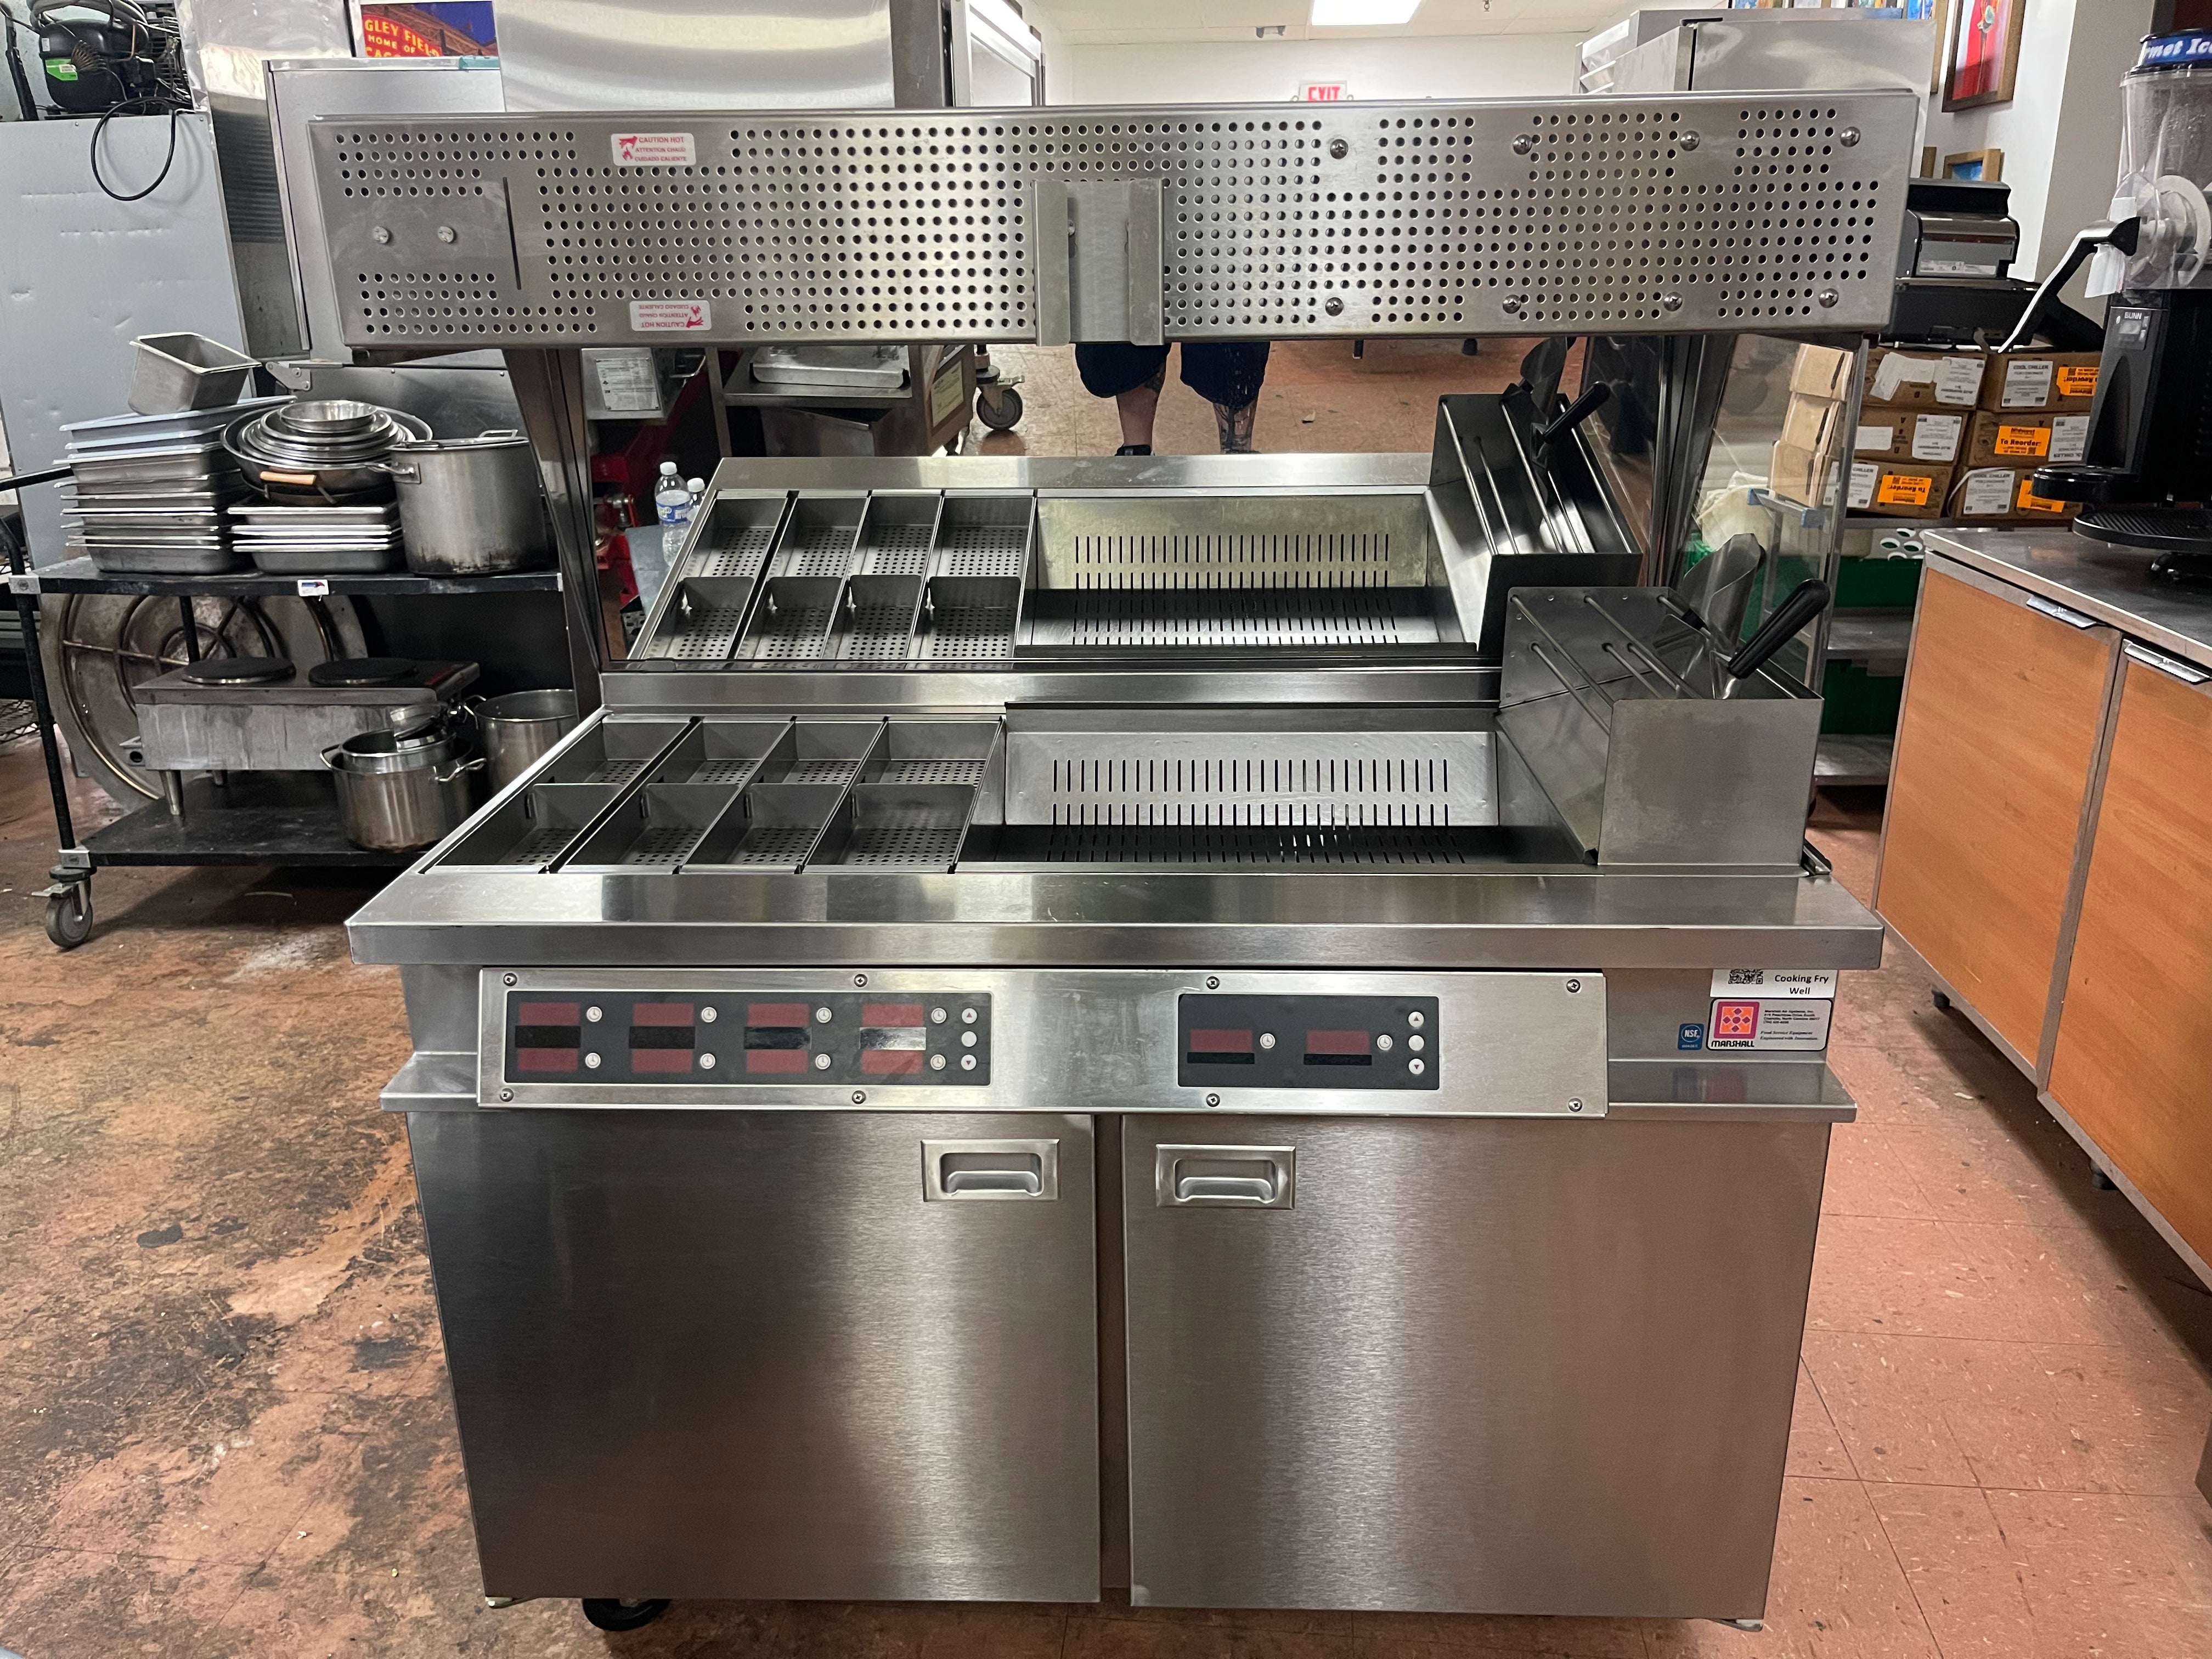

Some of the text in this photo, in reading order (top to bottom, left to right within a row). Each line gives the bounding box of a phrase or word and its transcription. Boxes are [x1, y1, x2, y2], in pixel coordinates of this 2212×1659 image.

[365, 19, 398, 36] GLEY
[368, 35, 416, 53] HOME OF
[2124, 312, 2142, 320] BUNN
[1775, 974, 1829, 984] Cooking Fry
[1685, 1029, 1698, 1037] NSF
